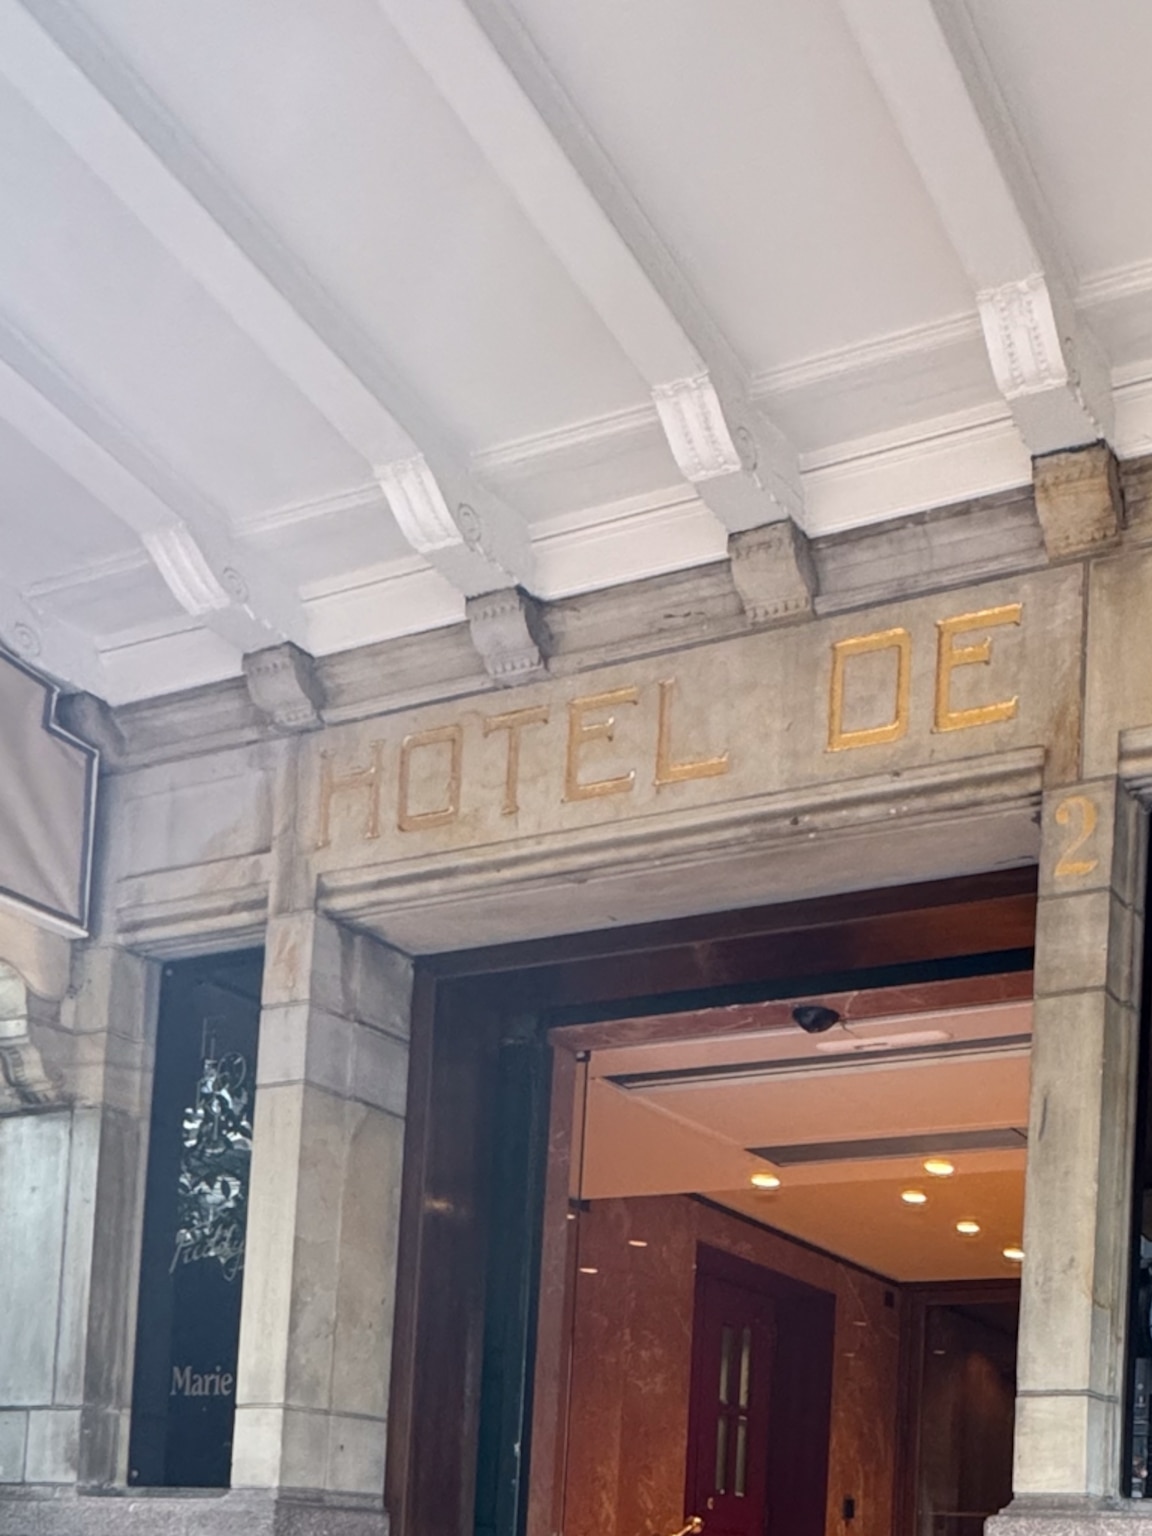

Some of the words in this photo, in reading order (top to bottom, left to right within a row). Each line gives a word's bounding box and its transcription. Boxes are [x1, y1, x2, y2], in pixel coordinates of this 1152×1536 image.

[315, 677, 731, 852] HOTEL
[825, 601, 1025, 754] DE
[1053, 794, 1100, 878] 2
[169, 1364, 234, 1397] Marie
